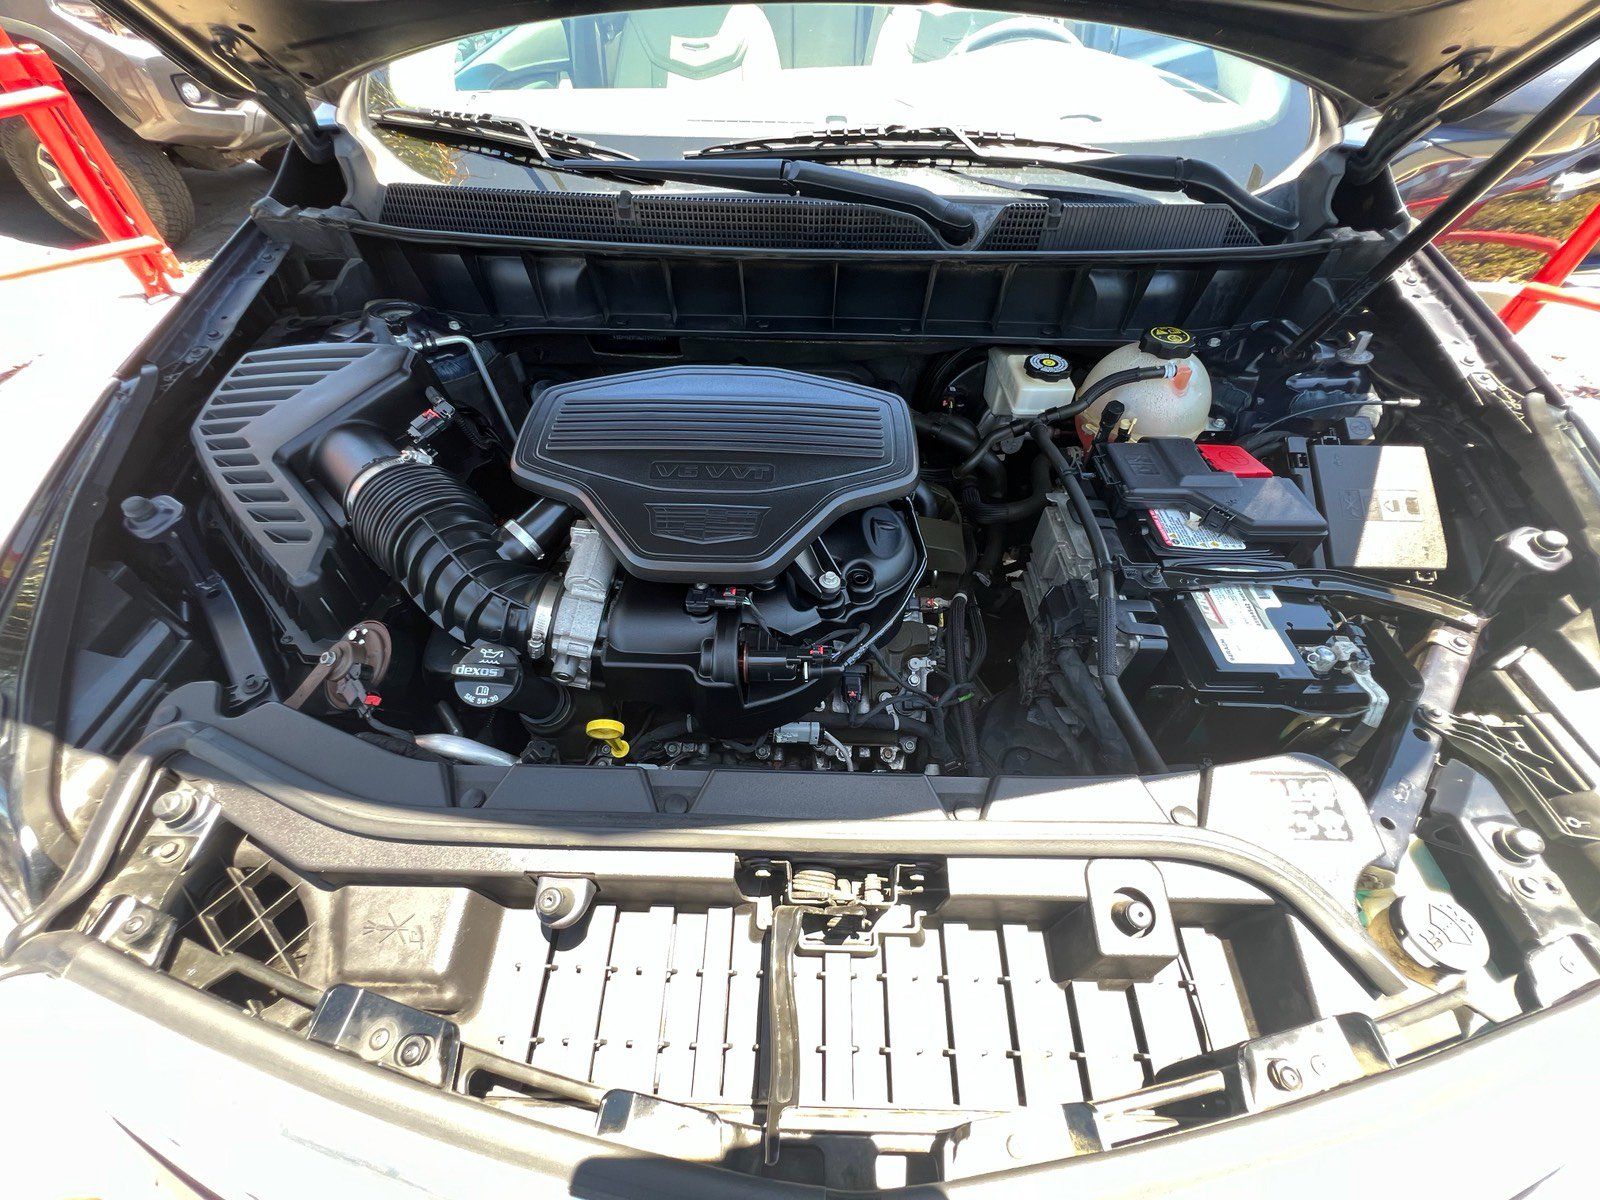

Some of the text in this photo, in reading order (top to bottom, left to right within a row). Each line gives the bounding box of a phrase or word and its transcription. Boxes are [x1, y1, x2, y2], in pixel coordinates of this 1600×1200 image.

[655, 464, 770, 480] V6 VVT
[455, 664, 500, 677] dexos
[464, 692, 499, 705] SAE 5W-30
